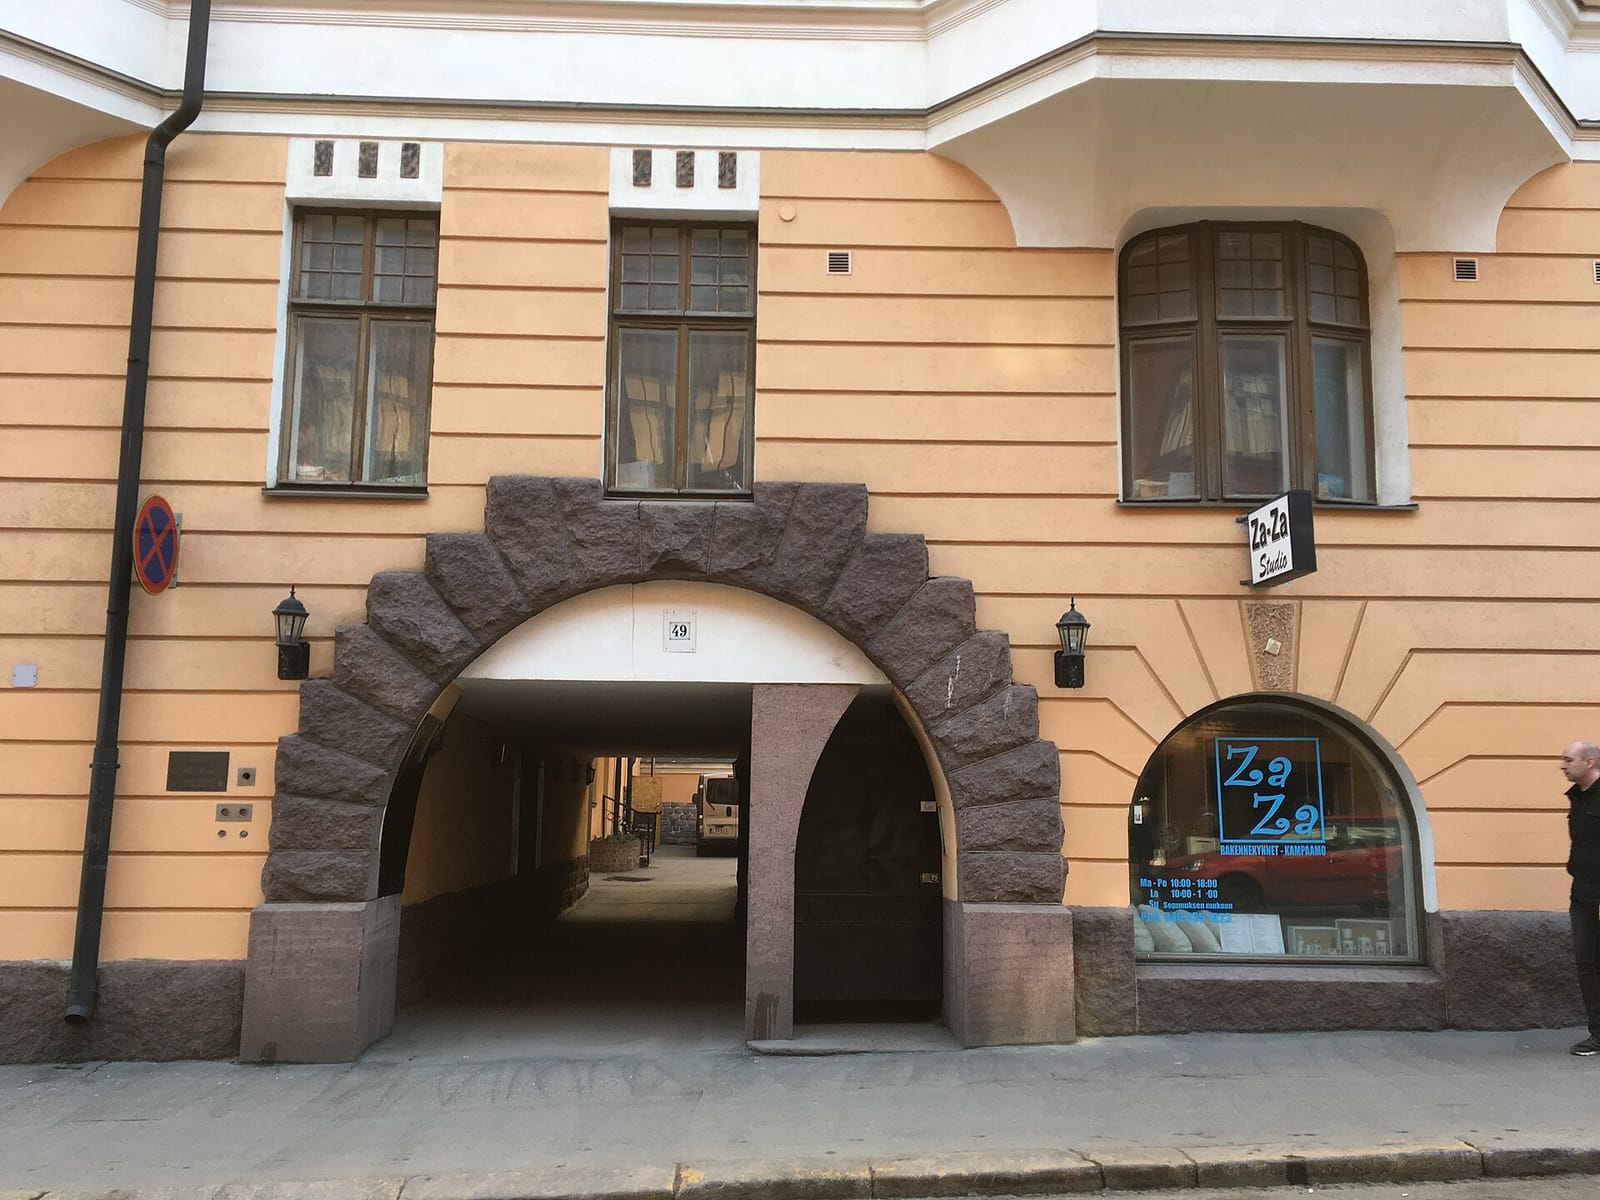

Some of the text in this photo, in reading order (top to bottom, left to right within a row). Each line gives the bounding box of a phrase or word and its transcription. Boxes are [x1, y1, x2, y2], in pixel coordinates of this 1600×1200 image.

[1259, 549, 1288, 578] Studio
[671, 624, 688, 638] 49
[1223, 744, 1292, 788] Za
[1249, 792, 1319, 836] Za
[1220, 845, 1279, 856] RAKENNEKYNNET
[1284, 845, 1327, 856] KAMPAAMO
[1150, 889, 1159, 898] La
